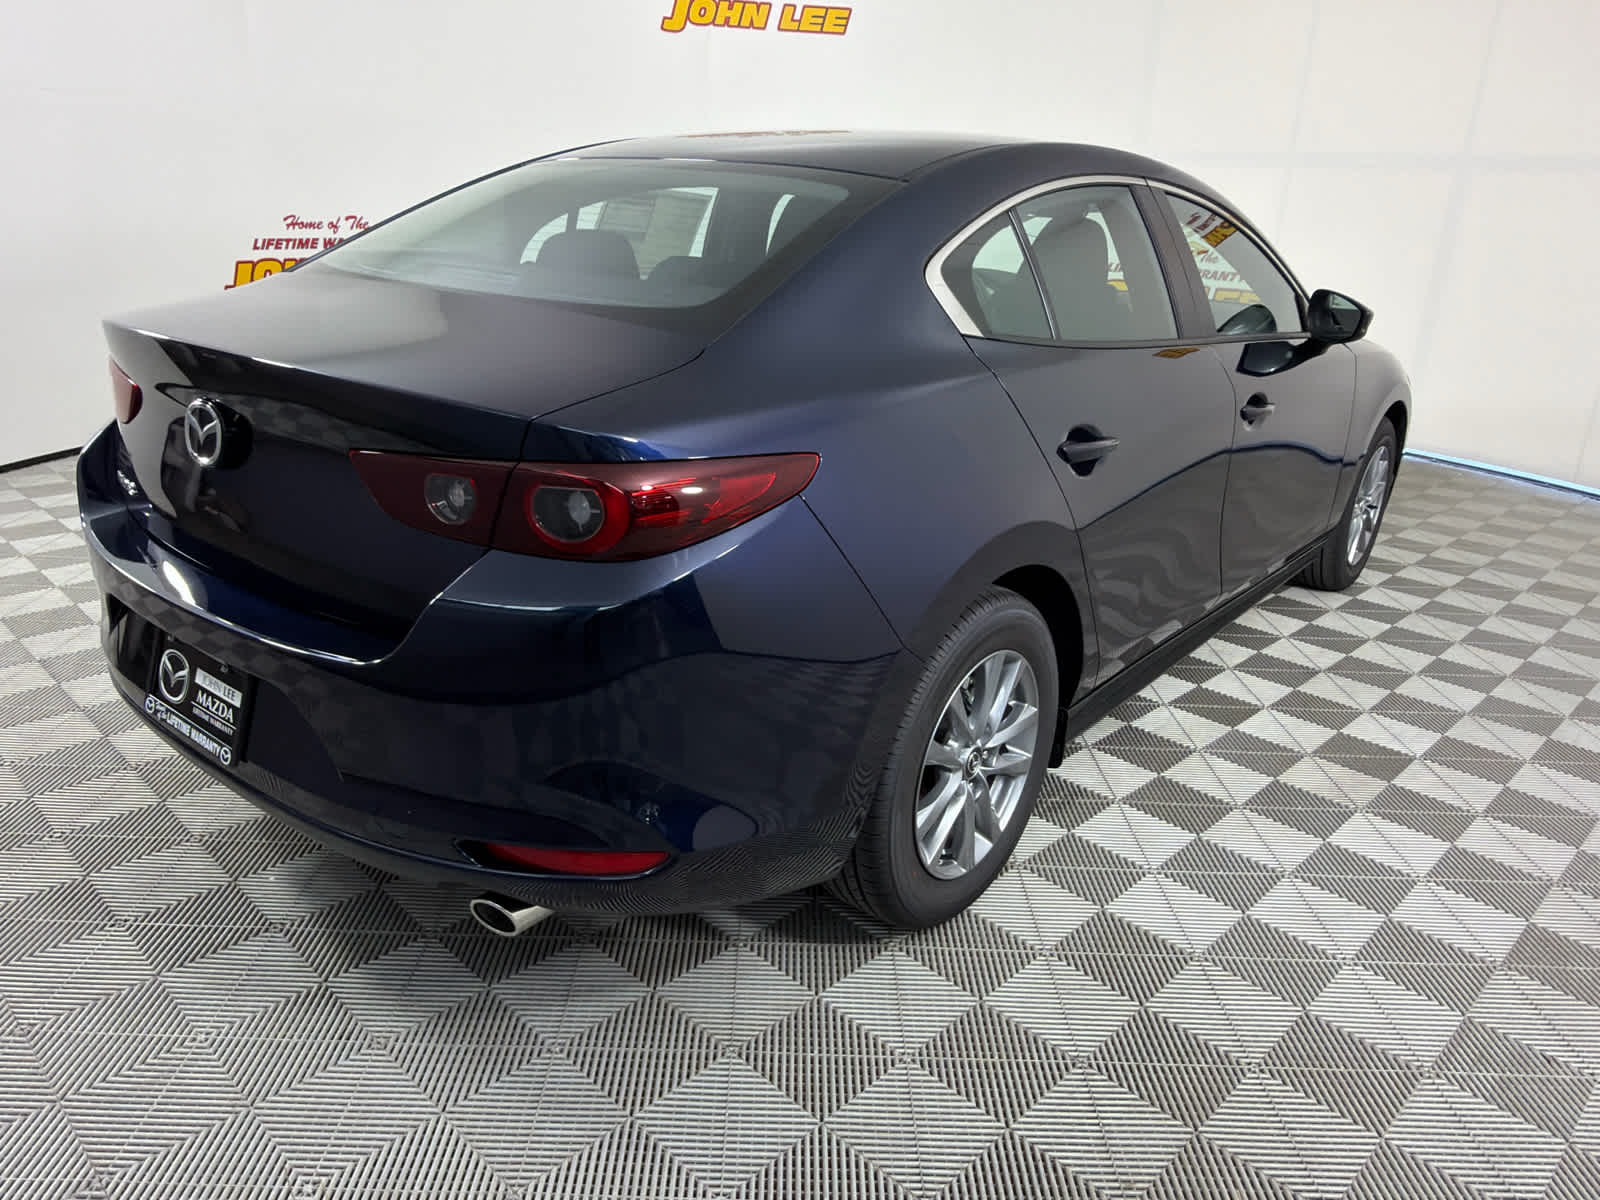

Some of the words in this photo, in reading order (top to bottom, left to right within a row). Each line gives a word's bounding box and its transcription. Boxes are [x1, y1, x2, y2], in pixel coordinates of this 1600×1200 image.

[661, 0, 771, 33] JOHN
[777, 4, 852, 35] LEE
[283, 214, 323, 231] Home
[327, 216, 341, 234] of
[344, 215, 369, 230] The
[252, 237, 319, 251] LIFETIME
[196, 689, 234, 723] MAZDA
[222, 685, 237, 702] LEE
[166, 711, 191, 737] LIFETIME
[190, 727, 222, 757] WARRANTY
